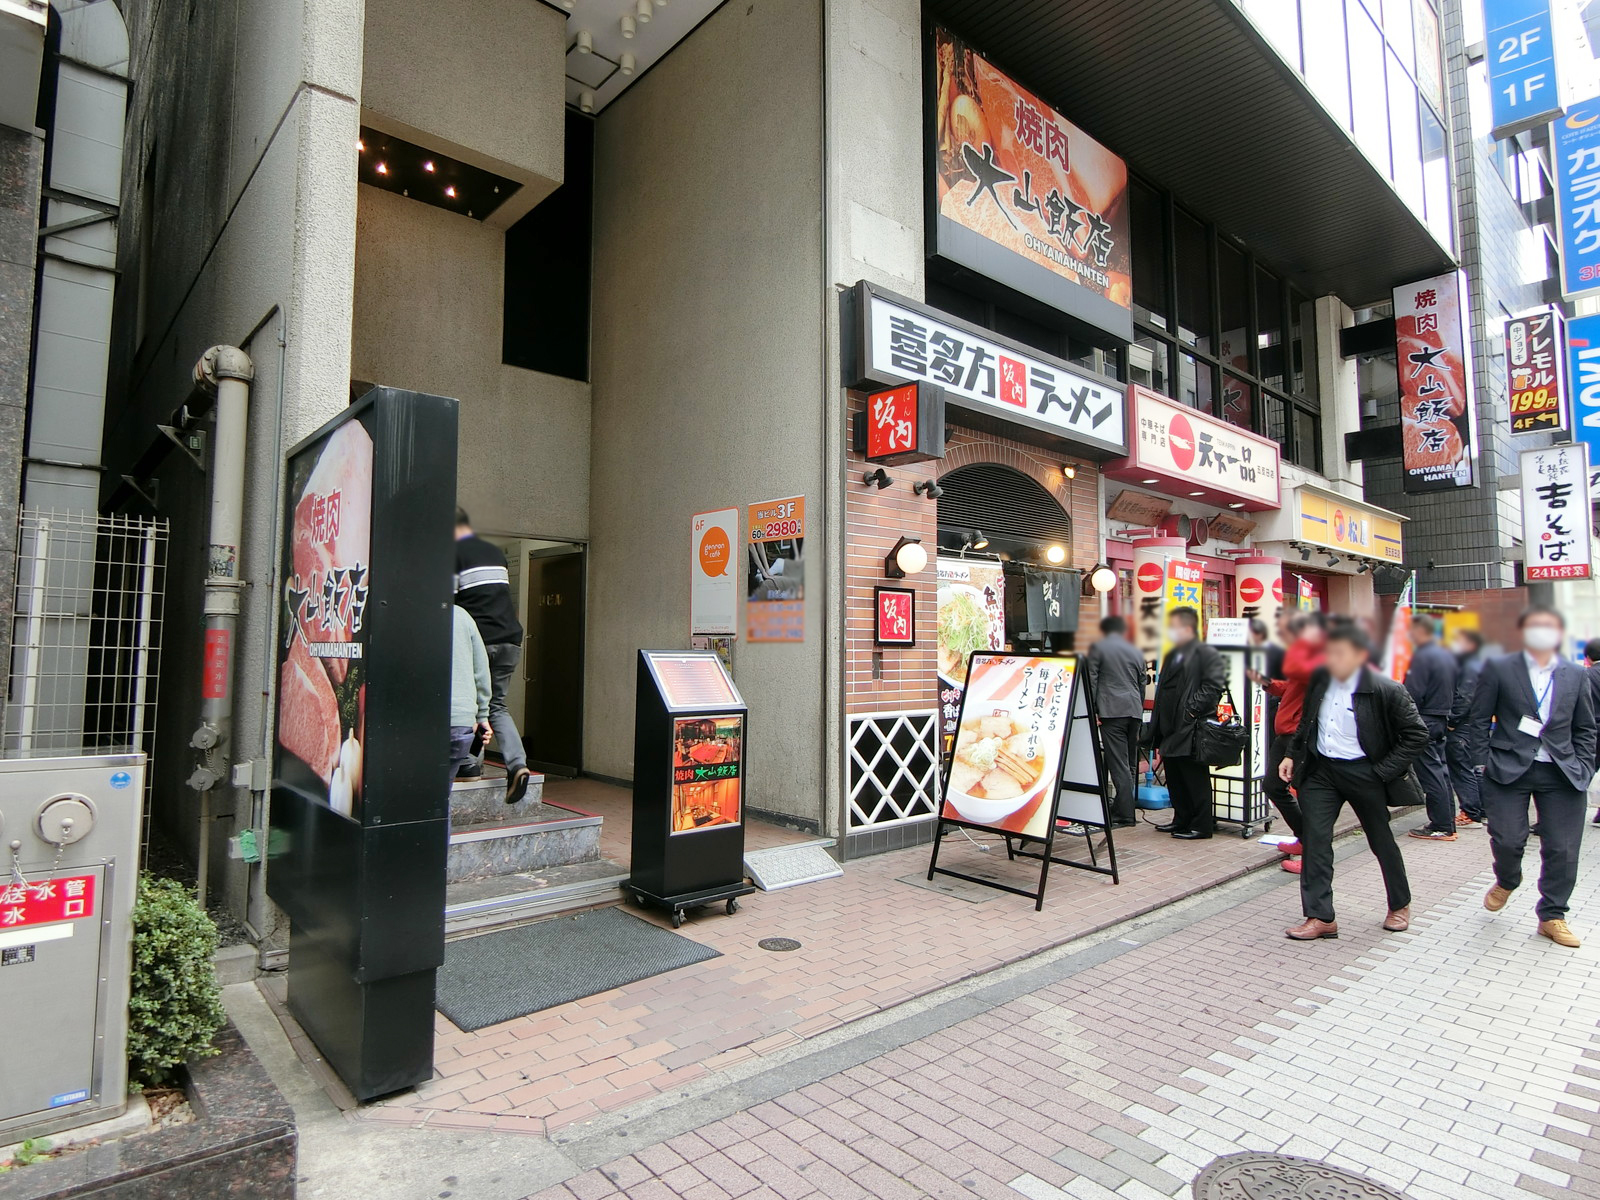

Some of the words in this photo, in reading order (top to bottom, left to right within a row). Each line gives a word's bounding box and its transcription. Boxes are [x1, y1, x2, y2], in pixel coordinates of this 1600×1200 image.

[1498, 26, 1541, 63] 2F
[1502, 73, 1546, 107] 1F
[1014, 96, 1070, 174] 焼肉
[961, 142, 1114, 267] 大山飯店
[1024, 233, 1109, 288] OHYAMAHANTEN
[1414, 289, 1438, 335] 焼肉
[1529, 314, 1554, 389] プレモル
[1408, 346, 1454, 453] 大山飯店
[1511, 388, 1558, 412] 199円
[1513, 417, 1535, 429] 4F
[1198, 431, 1256, 484] 天下一品
[1409, 463, 1453, 476] OHYAMA
[1423, 469, 1467, 482] HANTEN
[310, 487, 342, 548] 焼肉
[695, 519, 705, 531] 6F
[1535, 482, 1575, 561] 吉そば
[285, 560, 369, 649] 大山飯店
[309, 642, 363, 658] OHYAMAHANTEN
[1017, 667, 1034, 710] ラーメン
[1026, 667, 1050, 760] 毎日食べられる
[1048, 668, 1067, 731] くせになる
